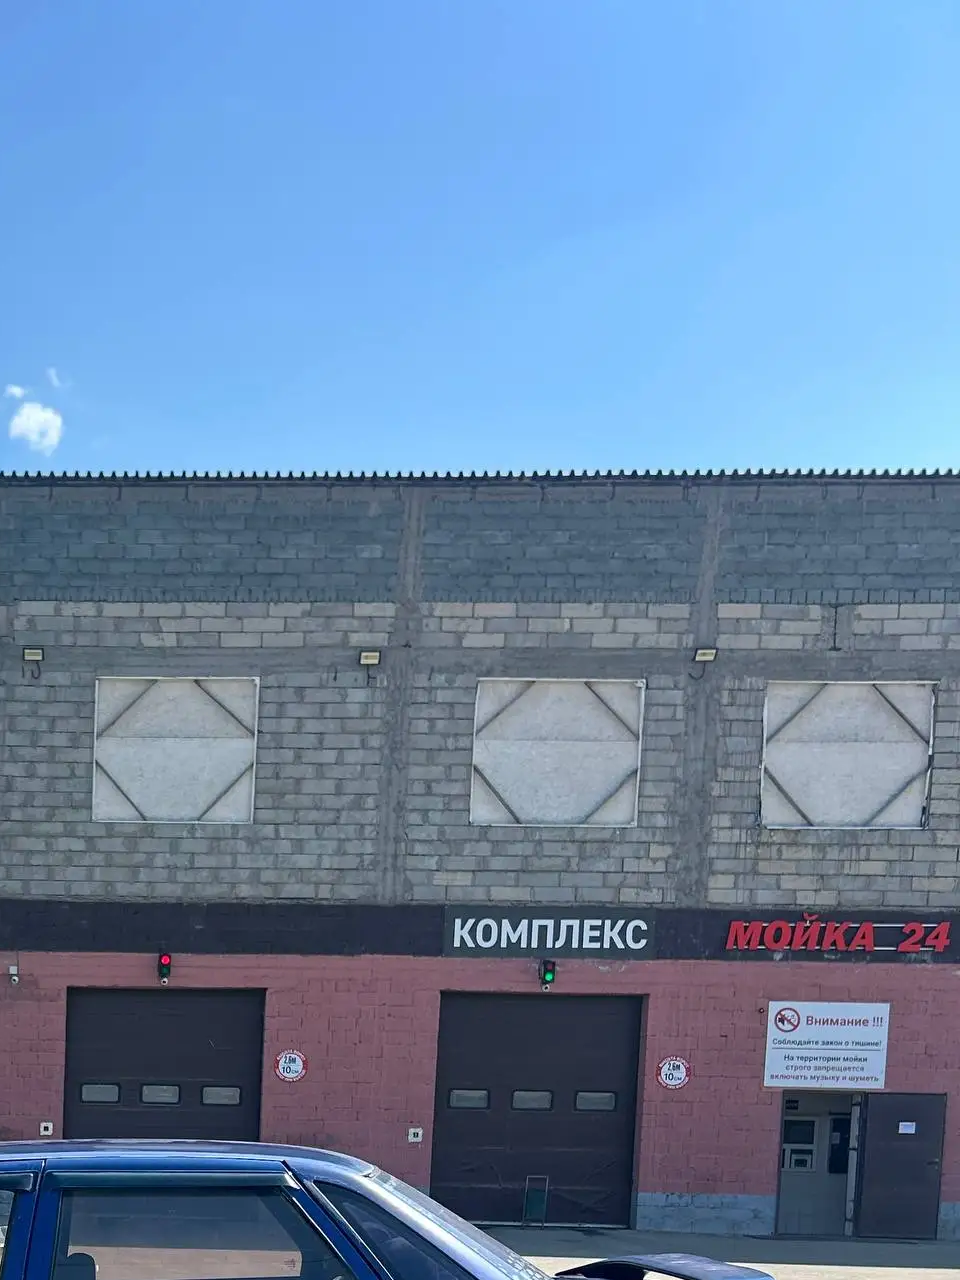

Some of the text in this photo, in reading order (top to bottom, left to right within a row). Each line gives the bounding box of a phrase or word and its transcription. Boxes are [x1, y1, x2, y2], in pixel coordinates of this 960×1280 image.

[453, 918, 648, 950] КОМПЛЕКС
[725, 911, 950, 952] МОЙКА 24
[806, 1015, 883, 1027] Внимание !!!
[772, 1038, 819, 1046] Соблюдайте
